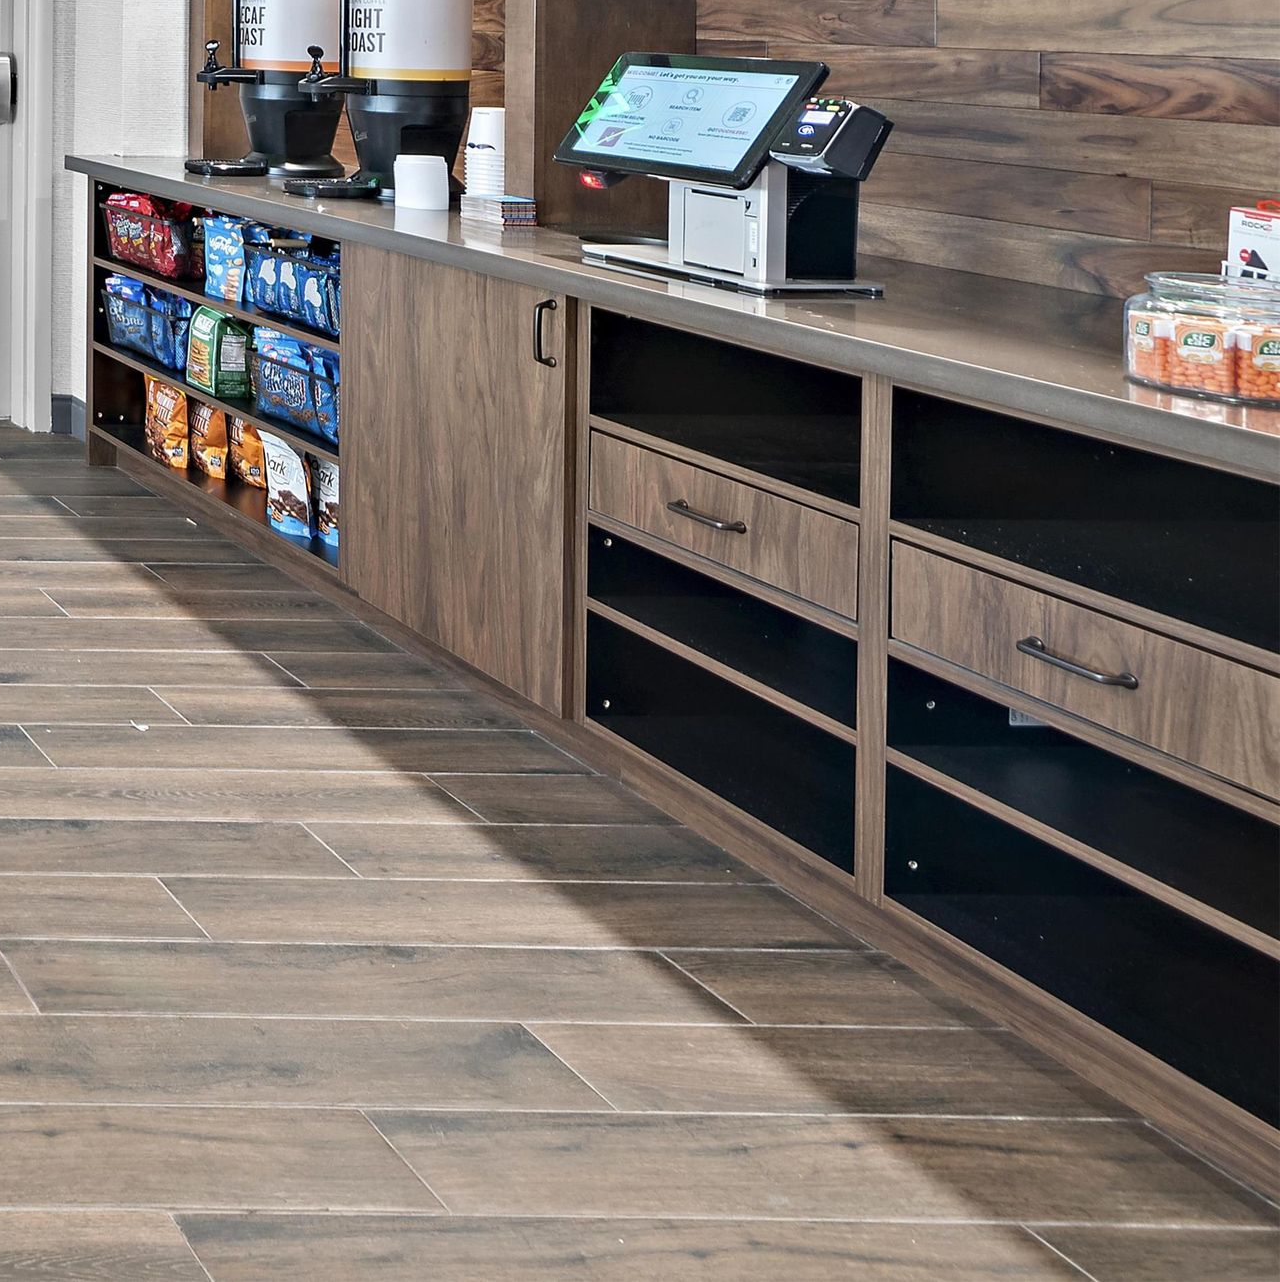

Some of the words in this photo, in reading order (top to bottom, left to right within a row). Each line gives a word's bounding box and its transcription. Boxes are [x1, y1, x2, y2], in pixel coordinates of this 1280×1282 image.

[240, 6, 266, 24] ECAF
[351, 8, 383, 28] IGHT
[240, 28, 266, 46] OAST
